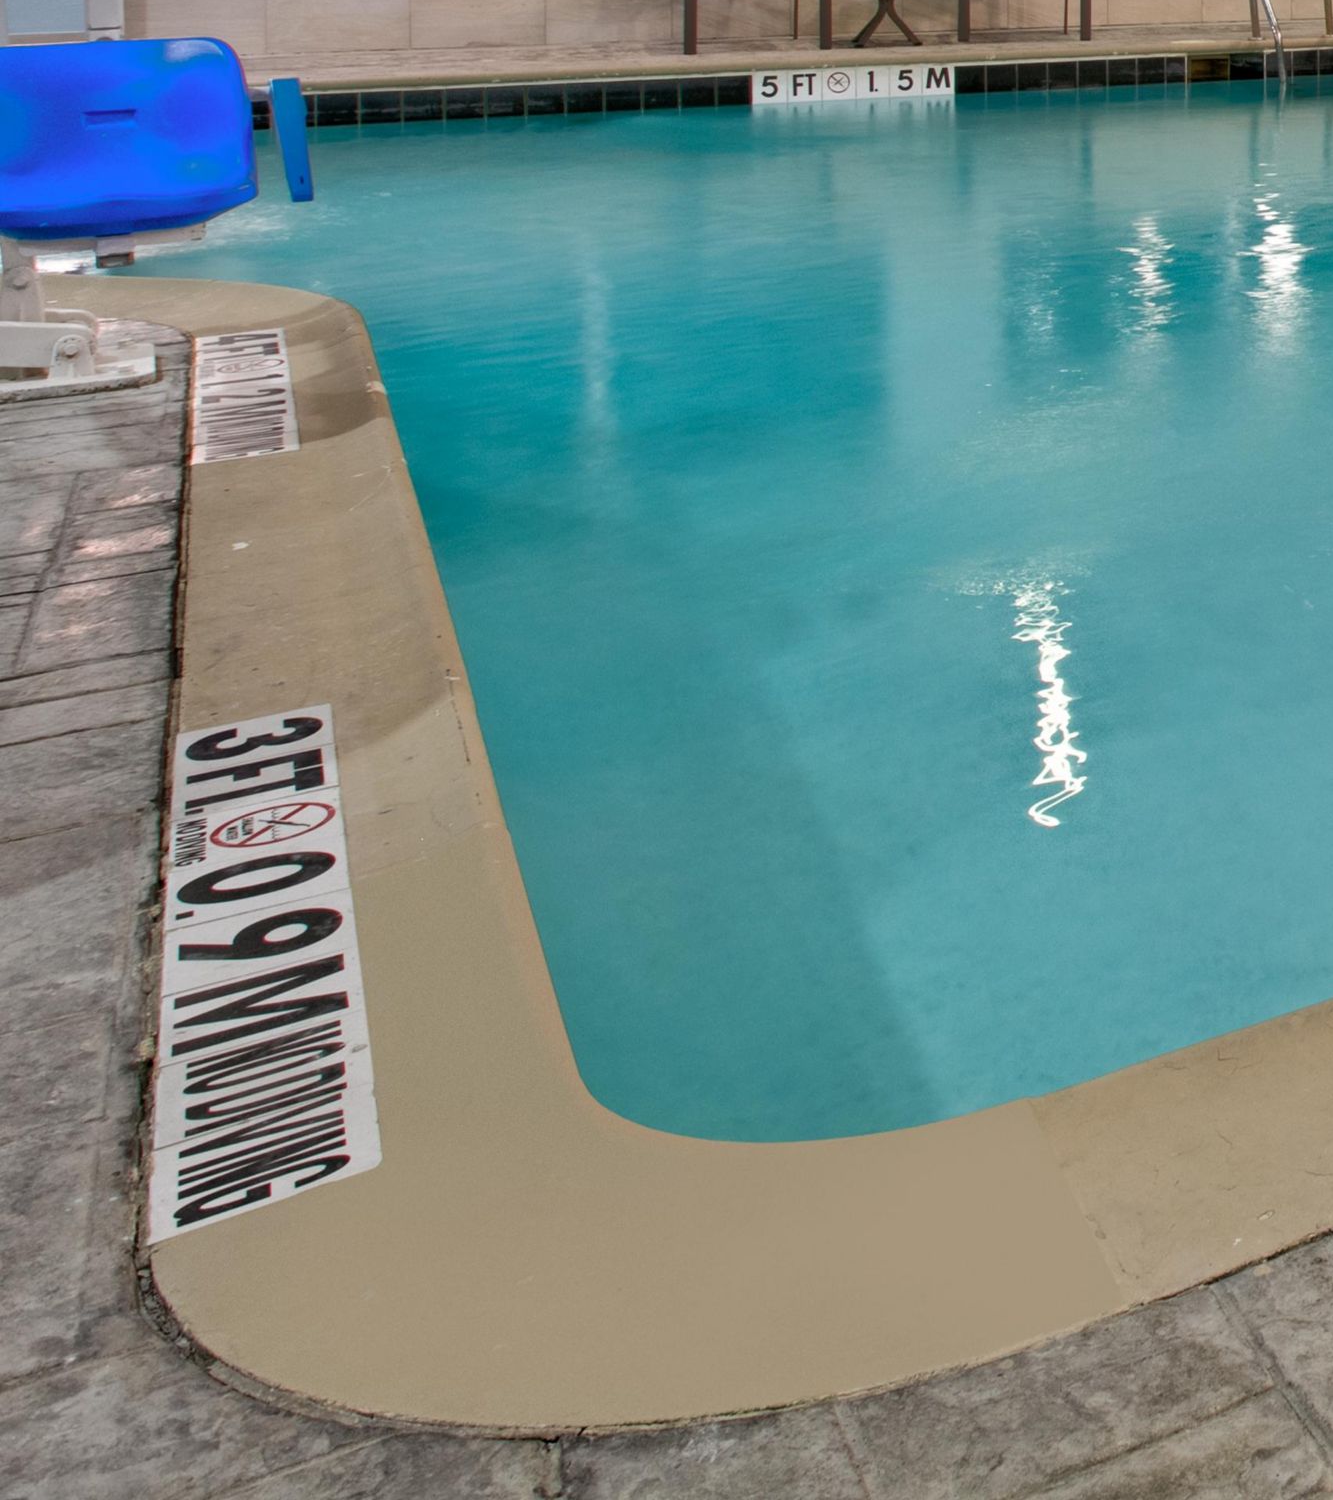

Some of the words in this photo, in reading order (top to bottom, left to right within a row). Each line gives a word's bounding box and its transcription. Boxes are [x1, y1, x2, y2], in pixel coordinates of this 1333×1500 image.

[761, 76, 779, 98] 5
[793, 73, 817, 96] FT
[926, 67, 951, 89] M
[202, 333, 278, 346] 4
[200, 399, 287, 425] M
[185, 717, 323, 761] 3
[176, 818, 207, 835] NO
[175, 831, 207, 867] DIVING
[171, 953, 349, 1057] M
[183, 1019, 346, 1094] NO
[173, 1061, 351, 1228] DIVING
